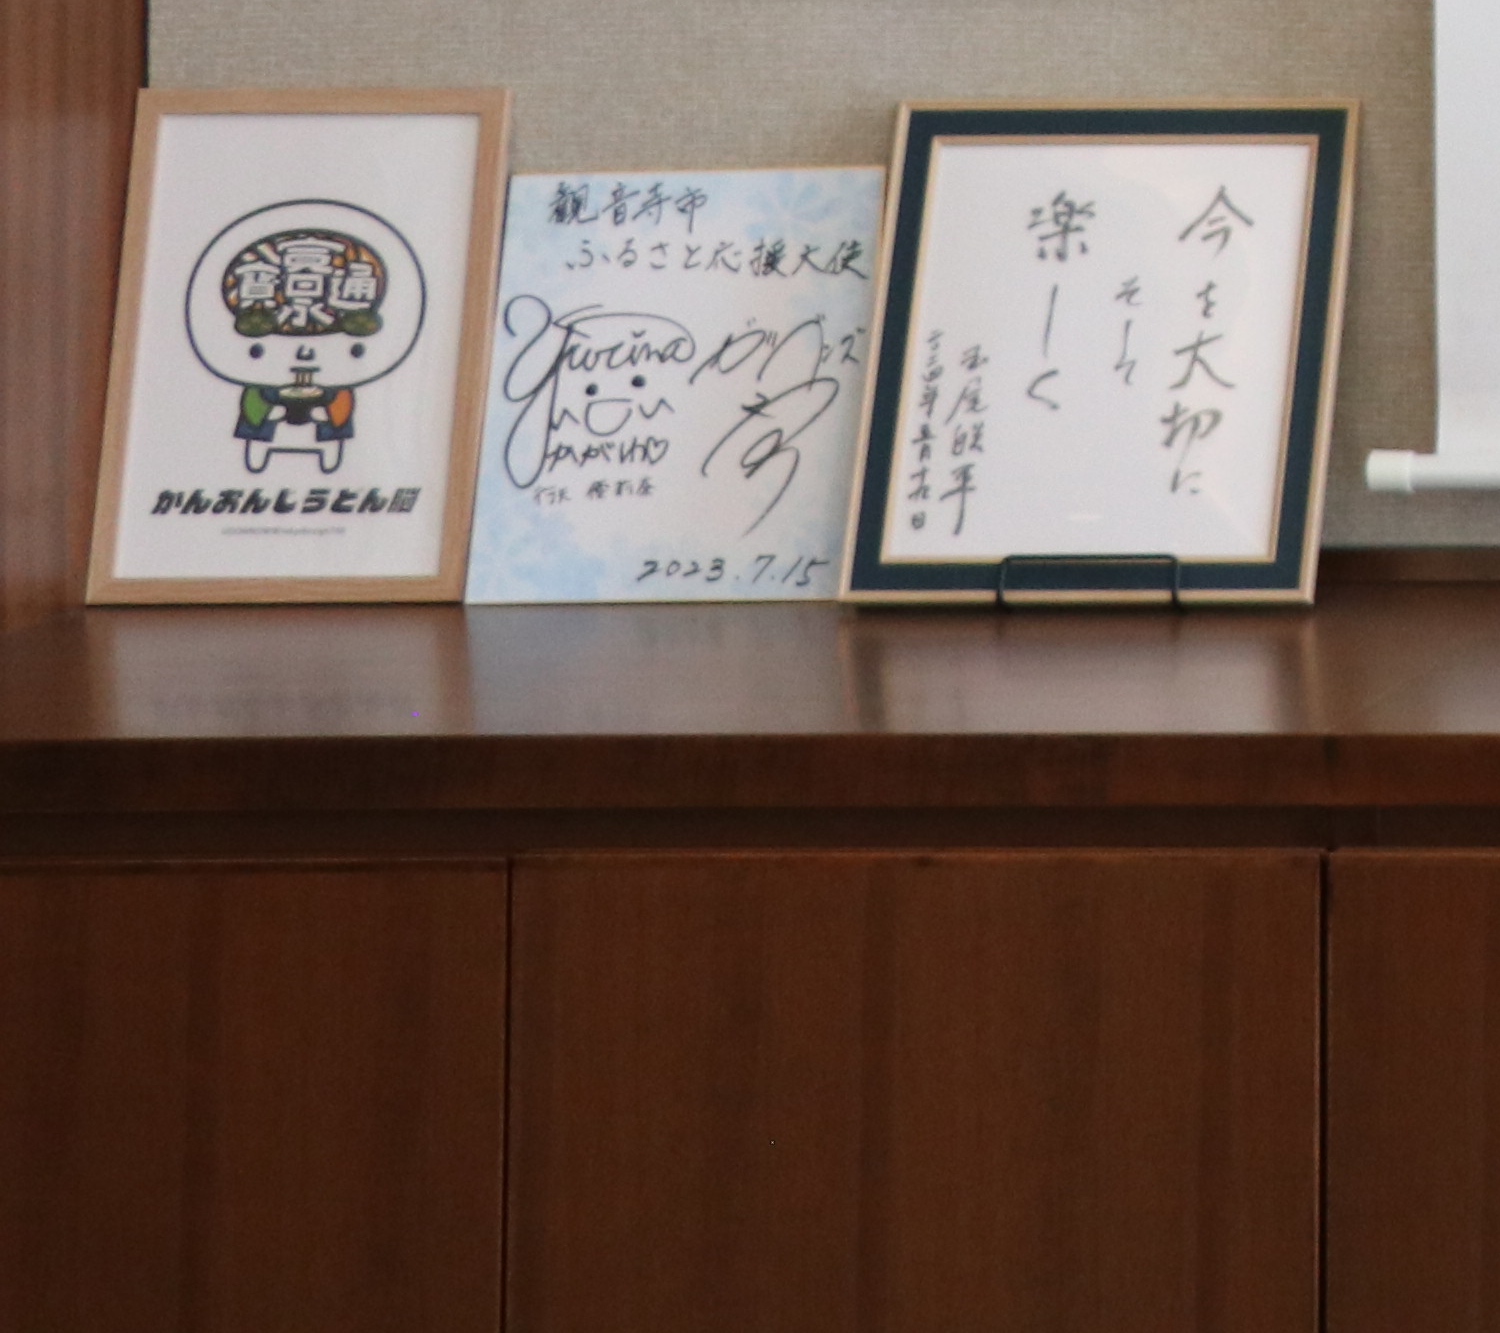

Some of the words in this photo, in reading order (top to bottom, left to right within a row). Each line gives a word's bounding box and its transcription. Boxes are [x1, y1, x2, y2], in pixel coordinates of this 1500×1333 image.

[1027, 191, 1095, 409] 楽しく
[1115, 280, 1139, 383] そして
[1160, 186, 1253, 493] 今を大切に
